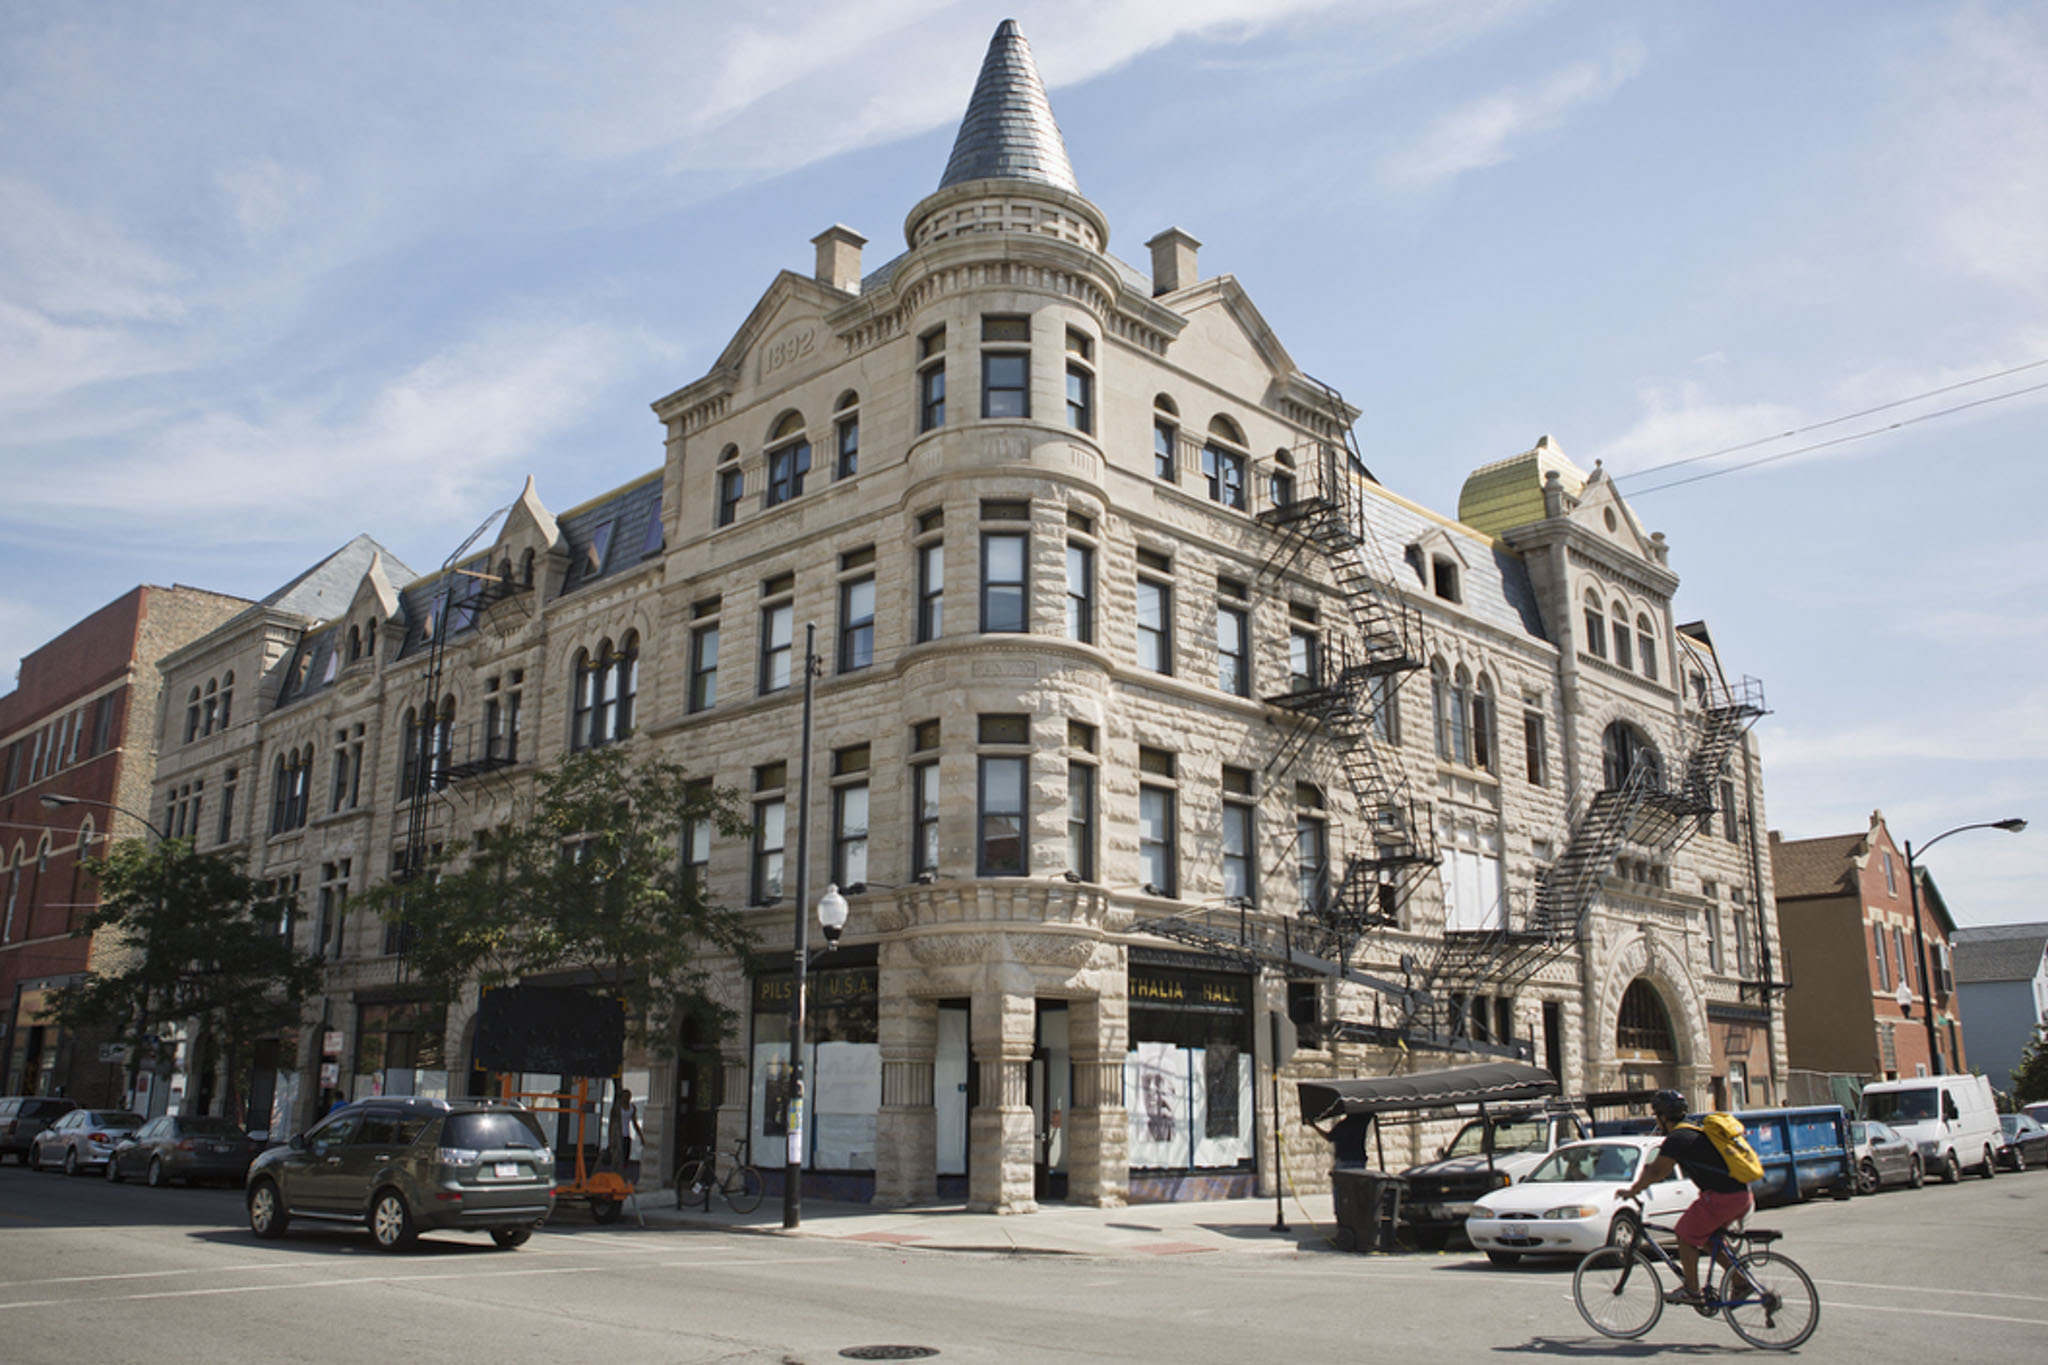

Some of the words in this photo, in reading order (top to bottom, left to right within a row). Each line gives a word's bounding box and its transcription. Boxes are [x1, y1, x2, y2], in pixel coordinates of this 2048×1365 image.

[766, 327, 815, 374] 1892
[761, 979, 812, 1000] PILSN
[1129, 977, 1184, 999] THALIA
[1203, 983, 1239, 1003] HALL
